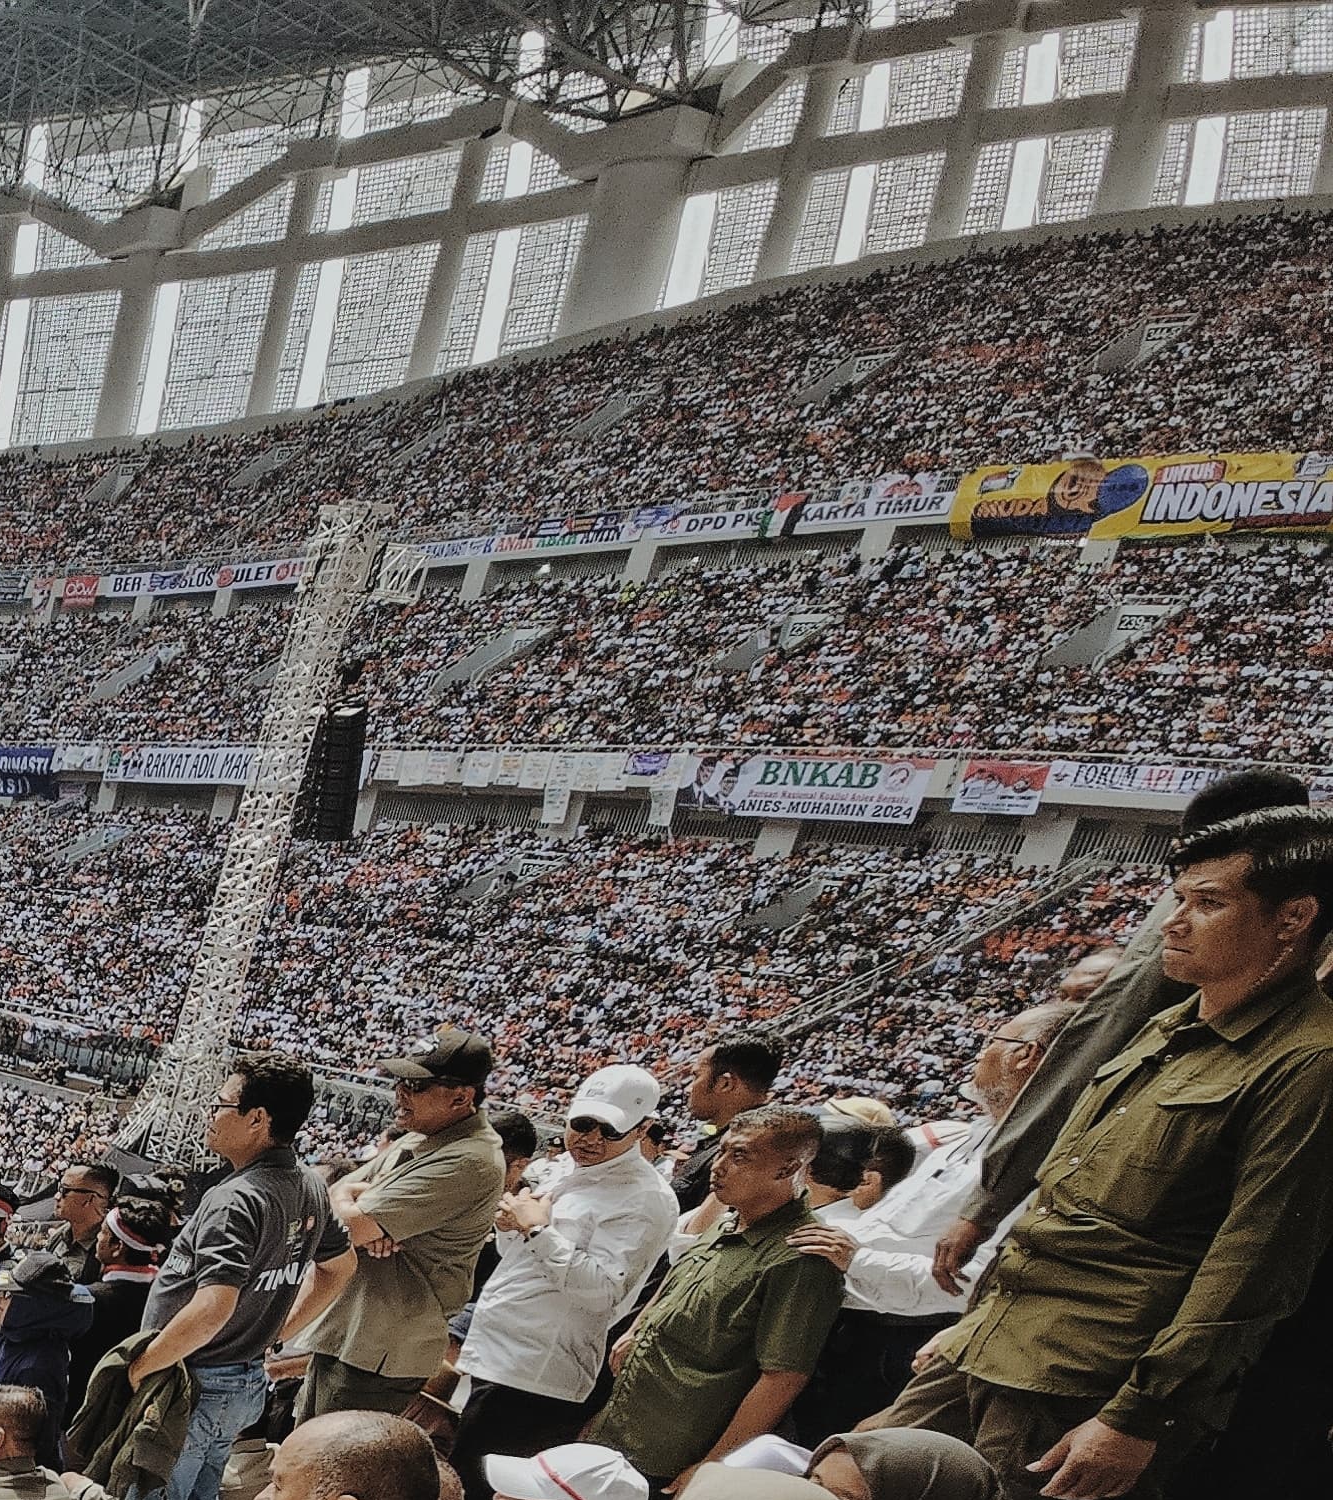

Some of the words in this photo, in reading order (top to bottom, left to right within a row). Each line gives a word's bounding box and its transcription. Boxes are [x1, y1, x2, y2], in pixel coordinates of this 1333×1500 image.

[1164, 463, 1217, 481] UNTUK
[875, 496, 944, 519] TIMUR
[1140, 480, 1333, 524] INDONESIA
[685, 513, 728, 533] DPD
[0, 757, 50, 775] DINASTI
[144, 753, 191, 778] RAKYAT
[194, 754, 218, 778] ADIL
[219, 754, 253, 779] MAK
[756, 759, 883, 790] BNKAB
[1073, 763, 1138, 788] FORUM
[1141, 767, 1177, 790] API
[736, 799, 866, 818] ANIES-MUHAIMIN
[872, 804, 914, 820] 2024
[254, 1261, 309, 1292] TIMN
